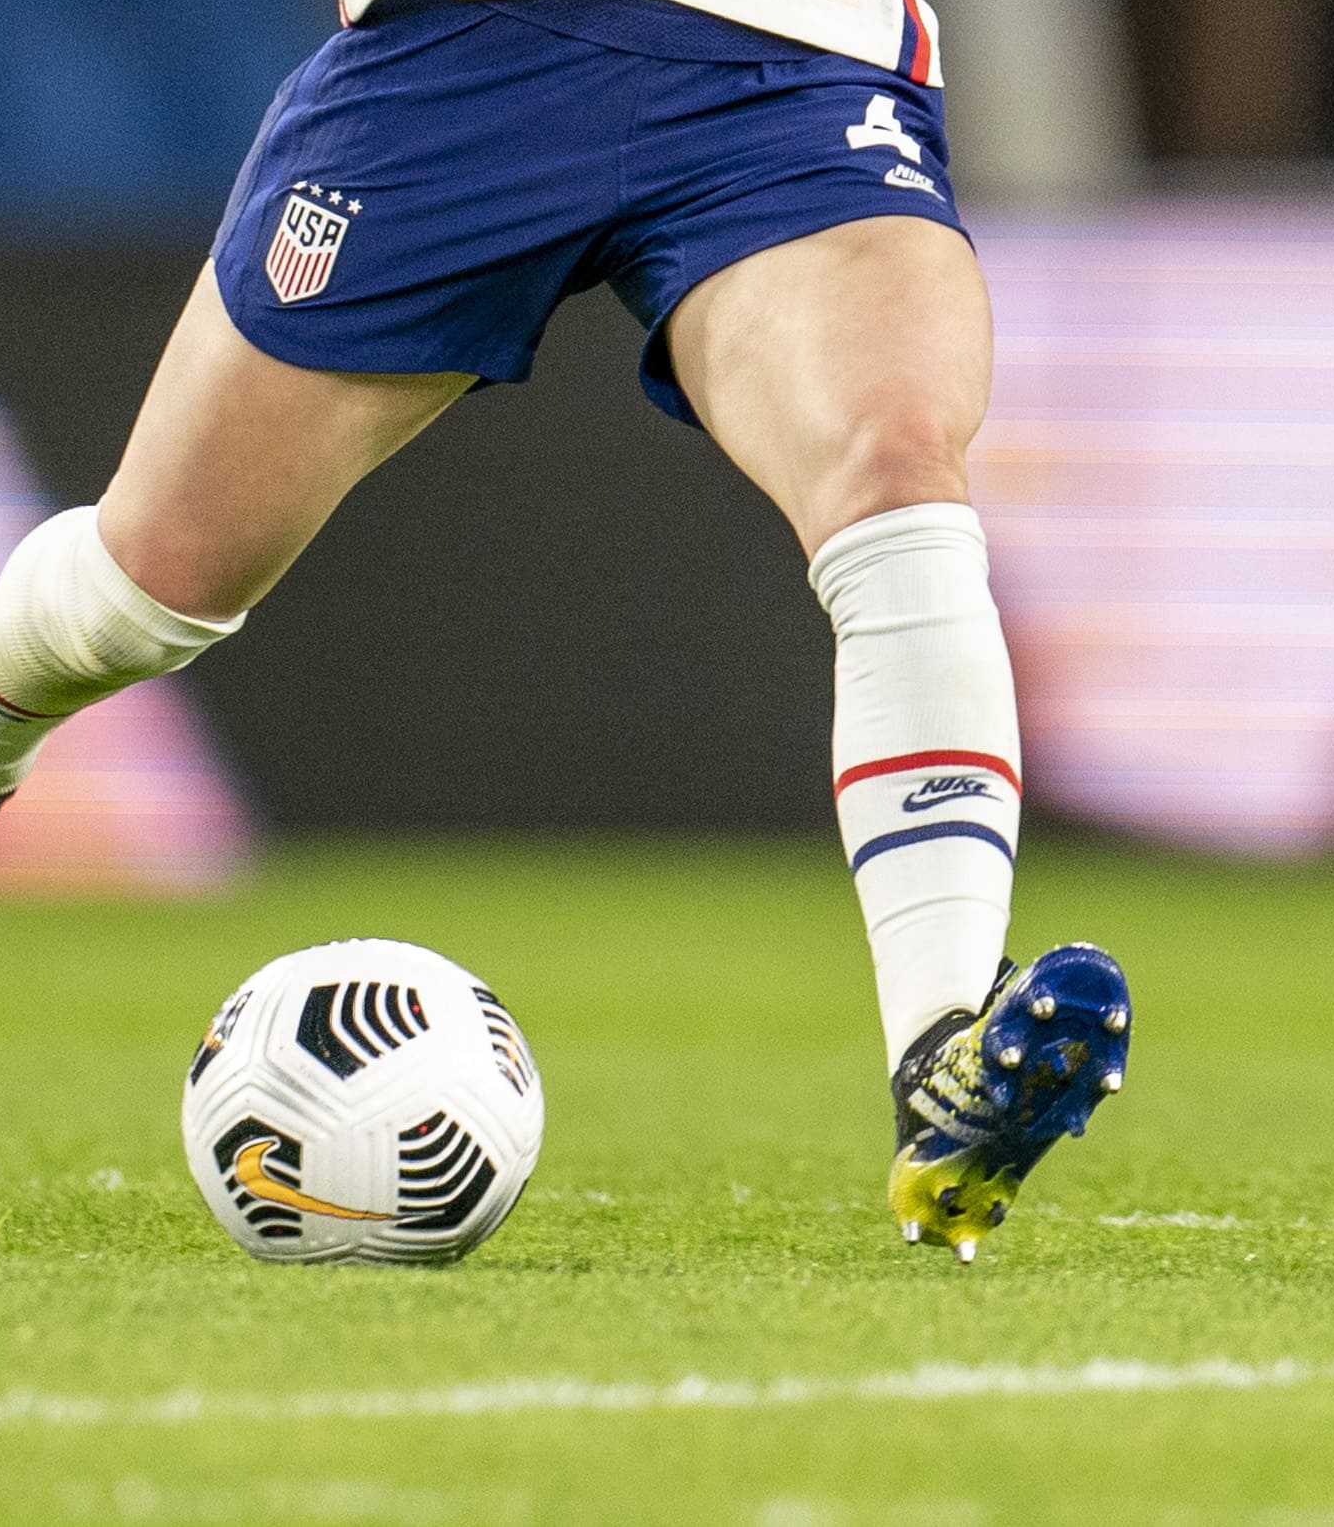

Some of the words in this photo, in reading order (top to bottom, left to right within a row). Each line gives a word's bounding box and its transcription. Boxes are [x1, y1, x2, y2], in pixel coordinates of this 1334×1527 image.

[845, 94, 922, 165] 4
[287, 202, 343, 247] USA
[917, 777, 989, 795] NIKE
